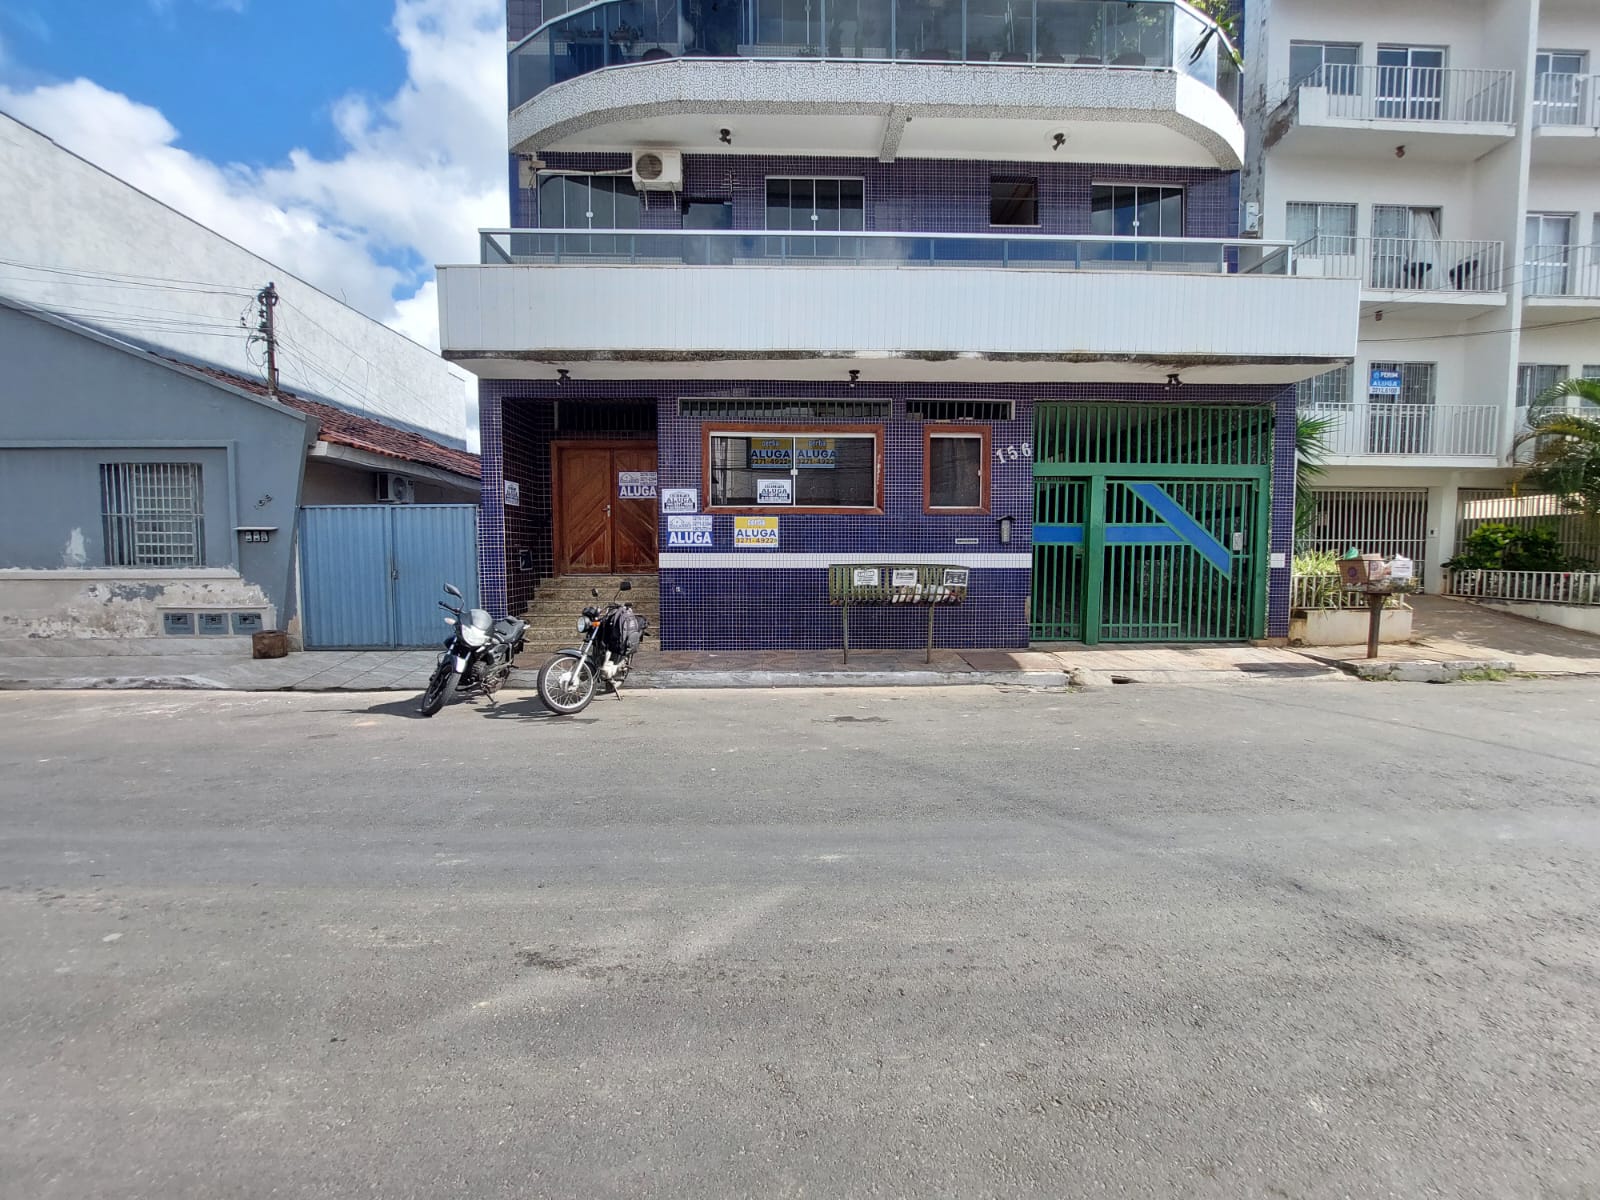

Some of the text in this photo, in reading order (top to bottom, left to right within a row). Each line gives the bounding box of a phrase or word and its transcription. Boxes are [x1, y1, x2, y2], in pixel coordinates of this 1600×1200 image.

[751, 449, 790, 458] ALUGA
[797, 449, 838, 458] ALUGA
[996, 443, 1032, 464] 156
[619, 486, 657, 496] ALUGA
[668, 531, 712, 544] ALUGA
[736, 529, 777, 537] ALUGA
